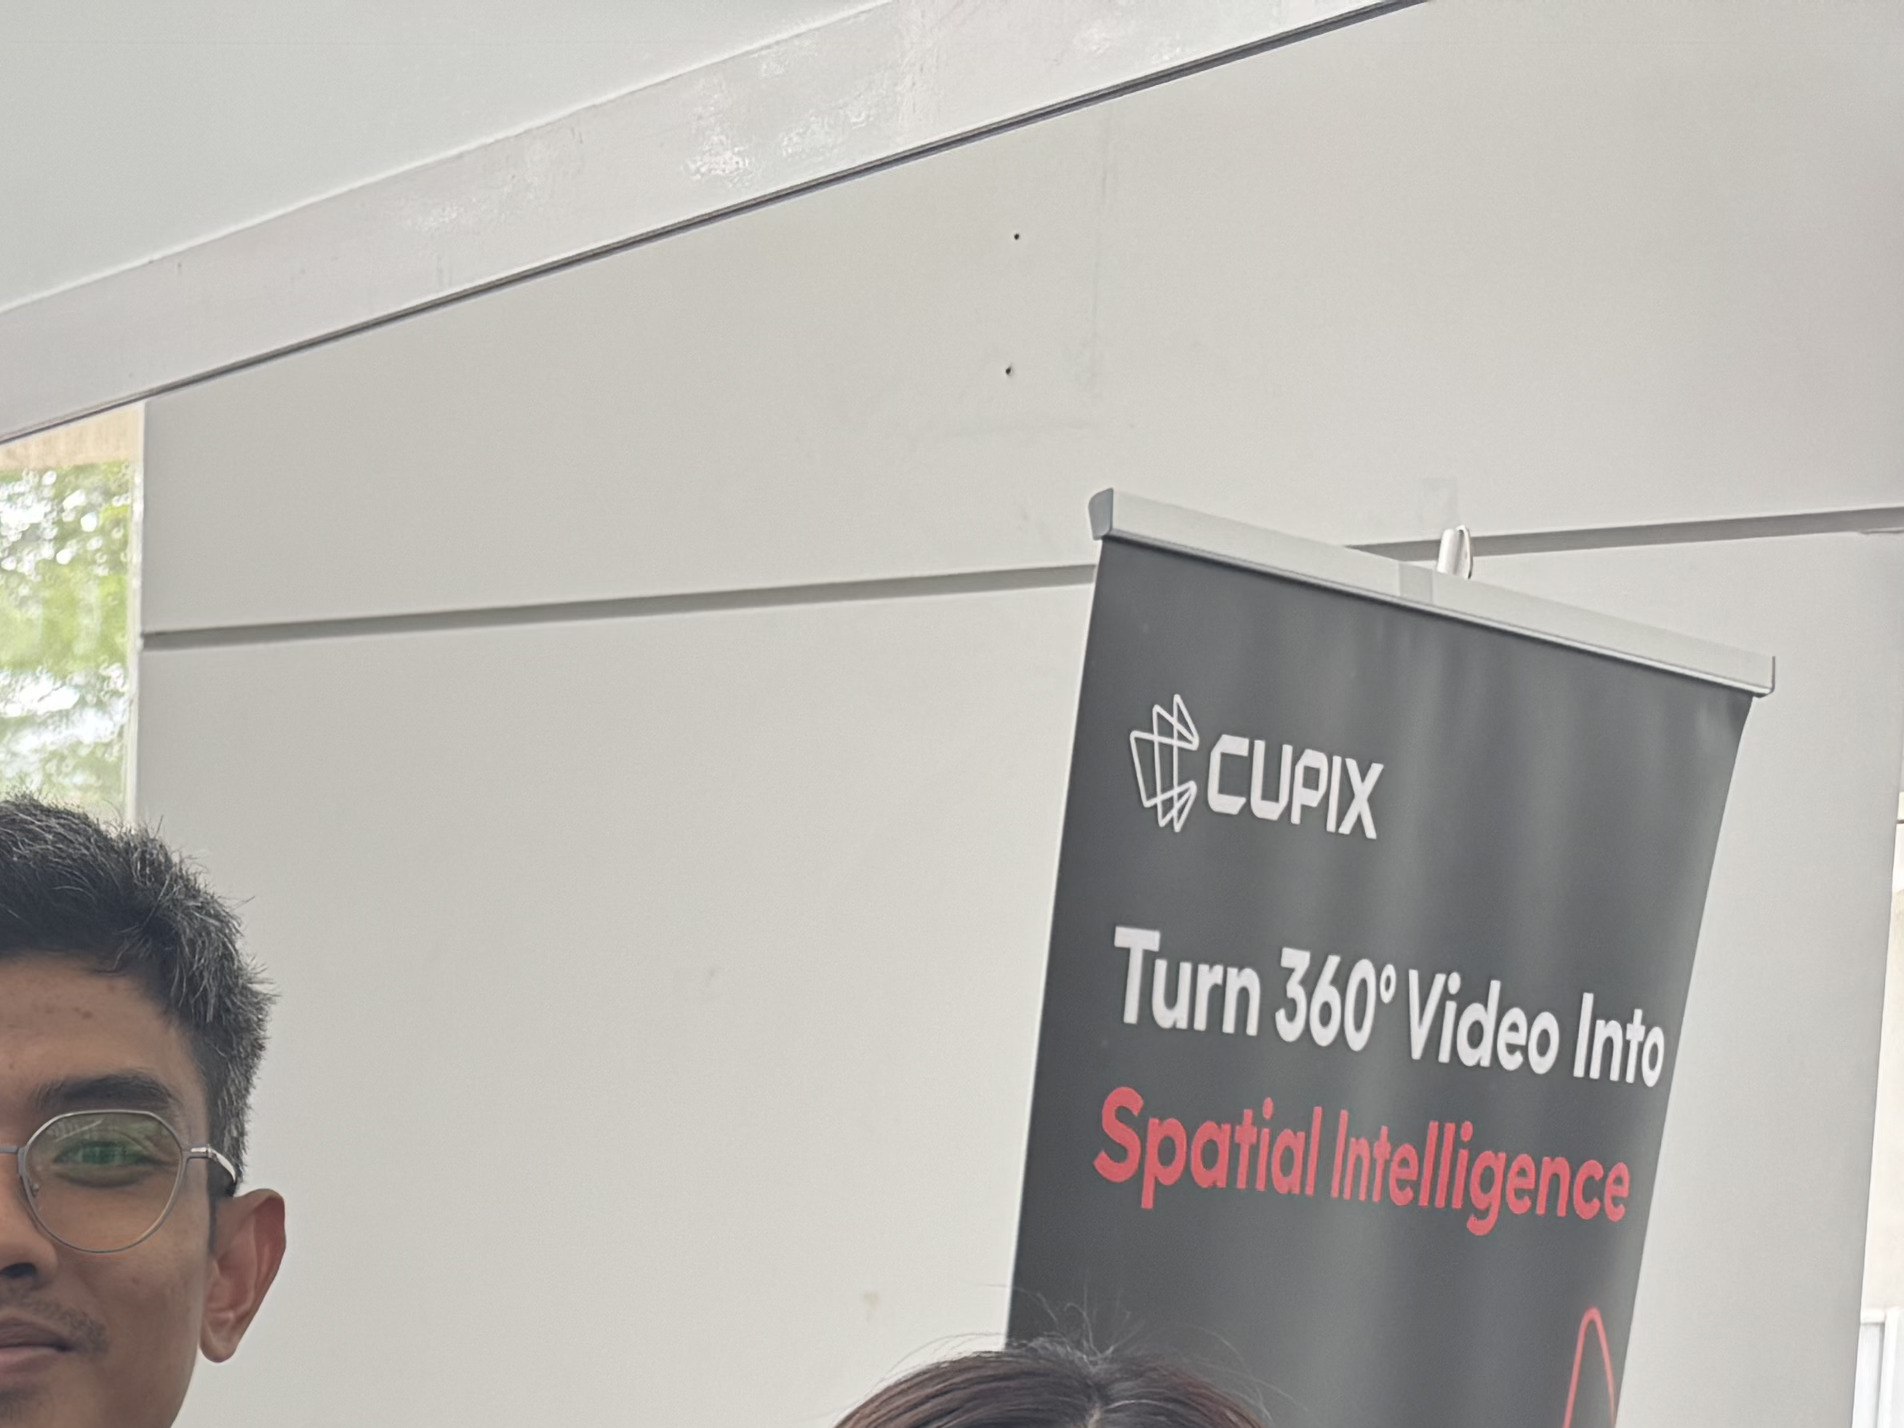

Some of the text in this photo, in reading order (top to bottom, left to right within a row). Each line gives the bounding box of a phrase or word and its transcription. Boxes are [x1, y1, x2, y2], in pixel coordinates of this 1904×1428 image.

[1207, 733, 1384, 839] CUPIX
[1114, 926, 1261, 1036] Turn
[1409, 969, 1560, 1074] Video
[1573, 992, 1665, 1088] Into
[1094, 1087, 1630, 1236] Spatial Intelligence
